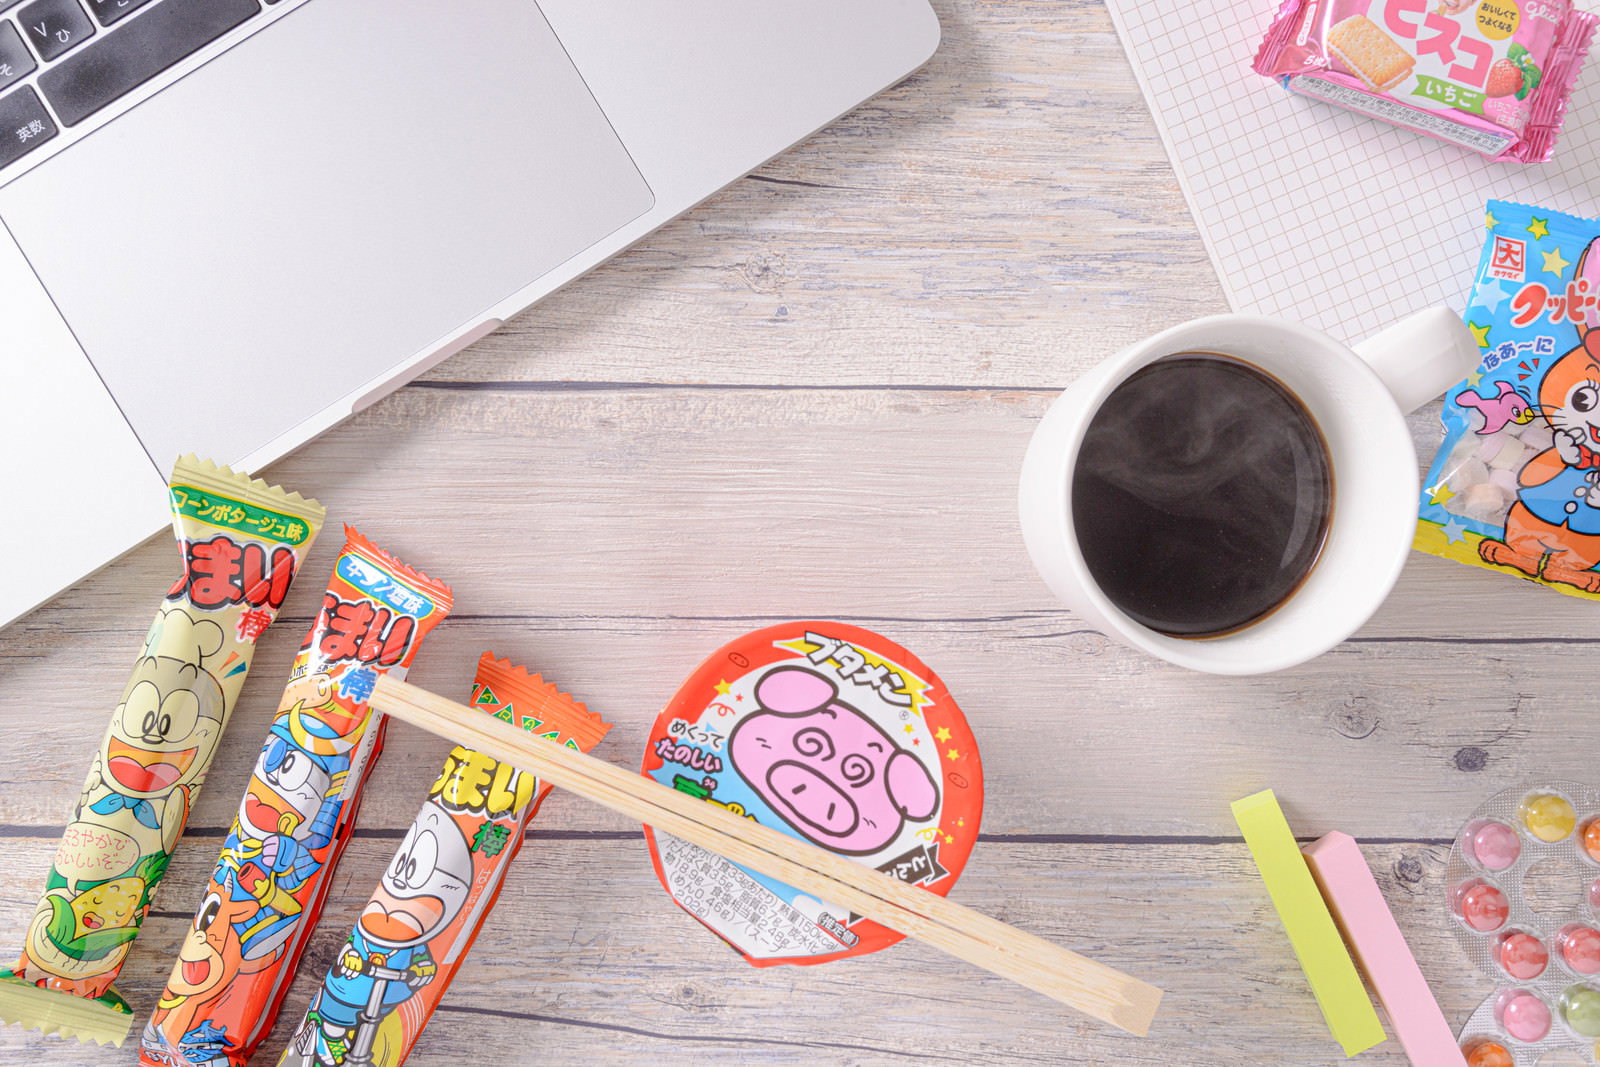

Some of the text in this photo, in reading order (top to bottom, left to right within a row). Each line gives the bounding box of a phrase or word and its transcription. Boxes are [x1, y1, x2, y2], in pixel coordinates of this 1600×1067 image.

[1479, 15, 1513, 33] つよくなる
[1482, 3, 1517, 20] おいしくて
[33, 22, 47, 37] V
[56, 29, 70, 43] ひ
[1425, 80, 1478, 108] いちご
[16, 119, 46, 143] 英数
[1497, 243, 1520, 267] 大
[1511, 280, 1600, 326] クッピー
[171, 489, 304, 542] コーンポタージュ味
[237, 608, 272, 645] 棒
[804, 630, 913, 707] ブタメン
[340, 667, 377, 701] 棒
[671, 720, 725, 749] めくって
[656, 737, 723, 774] たのしい
[471, 820, 511, 858] 棒
